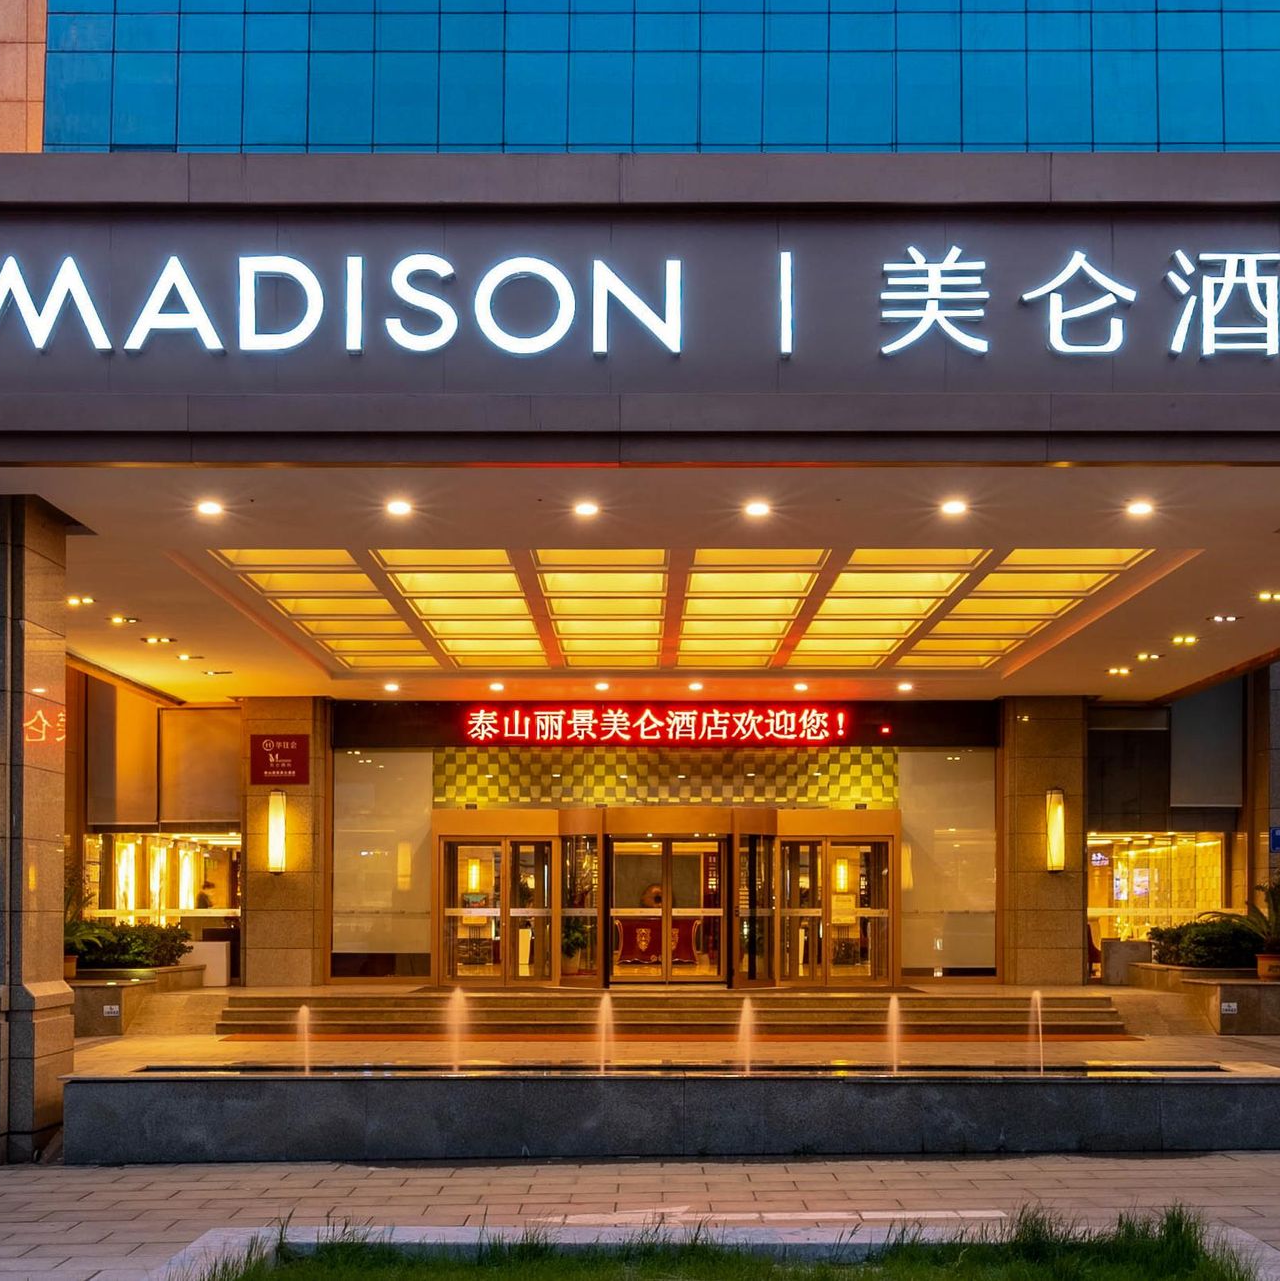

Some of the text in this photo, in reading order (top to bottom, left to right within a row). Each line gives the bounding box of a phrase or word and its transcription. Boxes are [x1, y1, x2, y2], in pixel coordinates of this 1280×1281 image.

[467, 708, 846, 741] 泰山丽景美仑酒店欢迎您！
